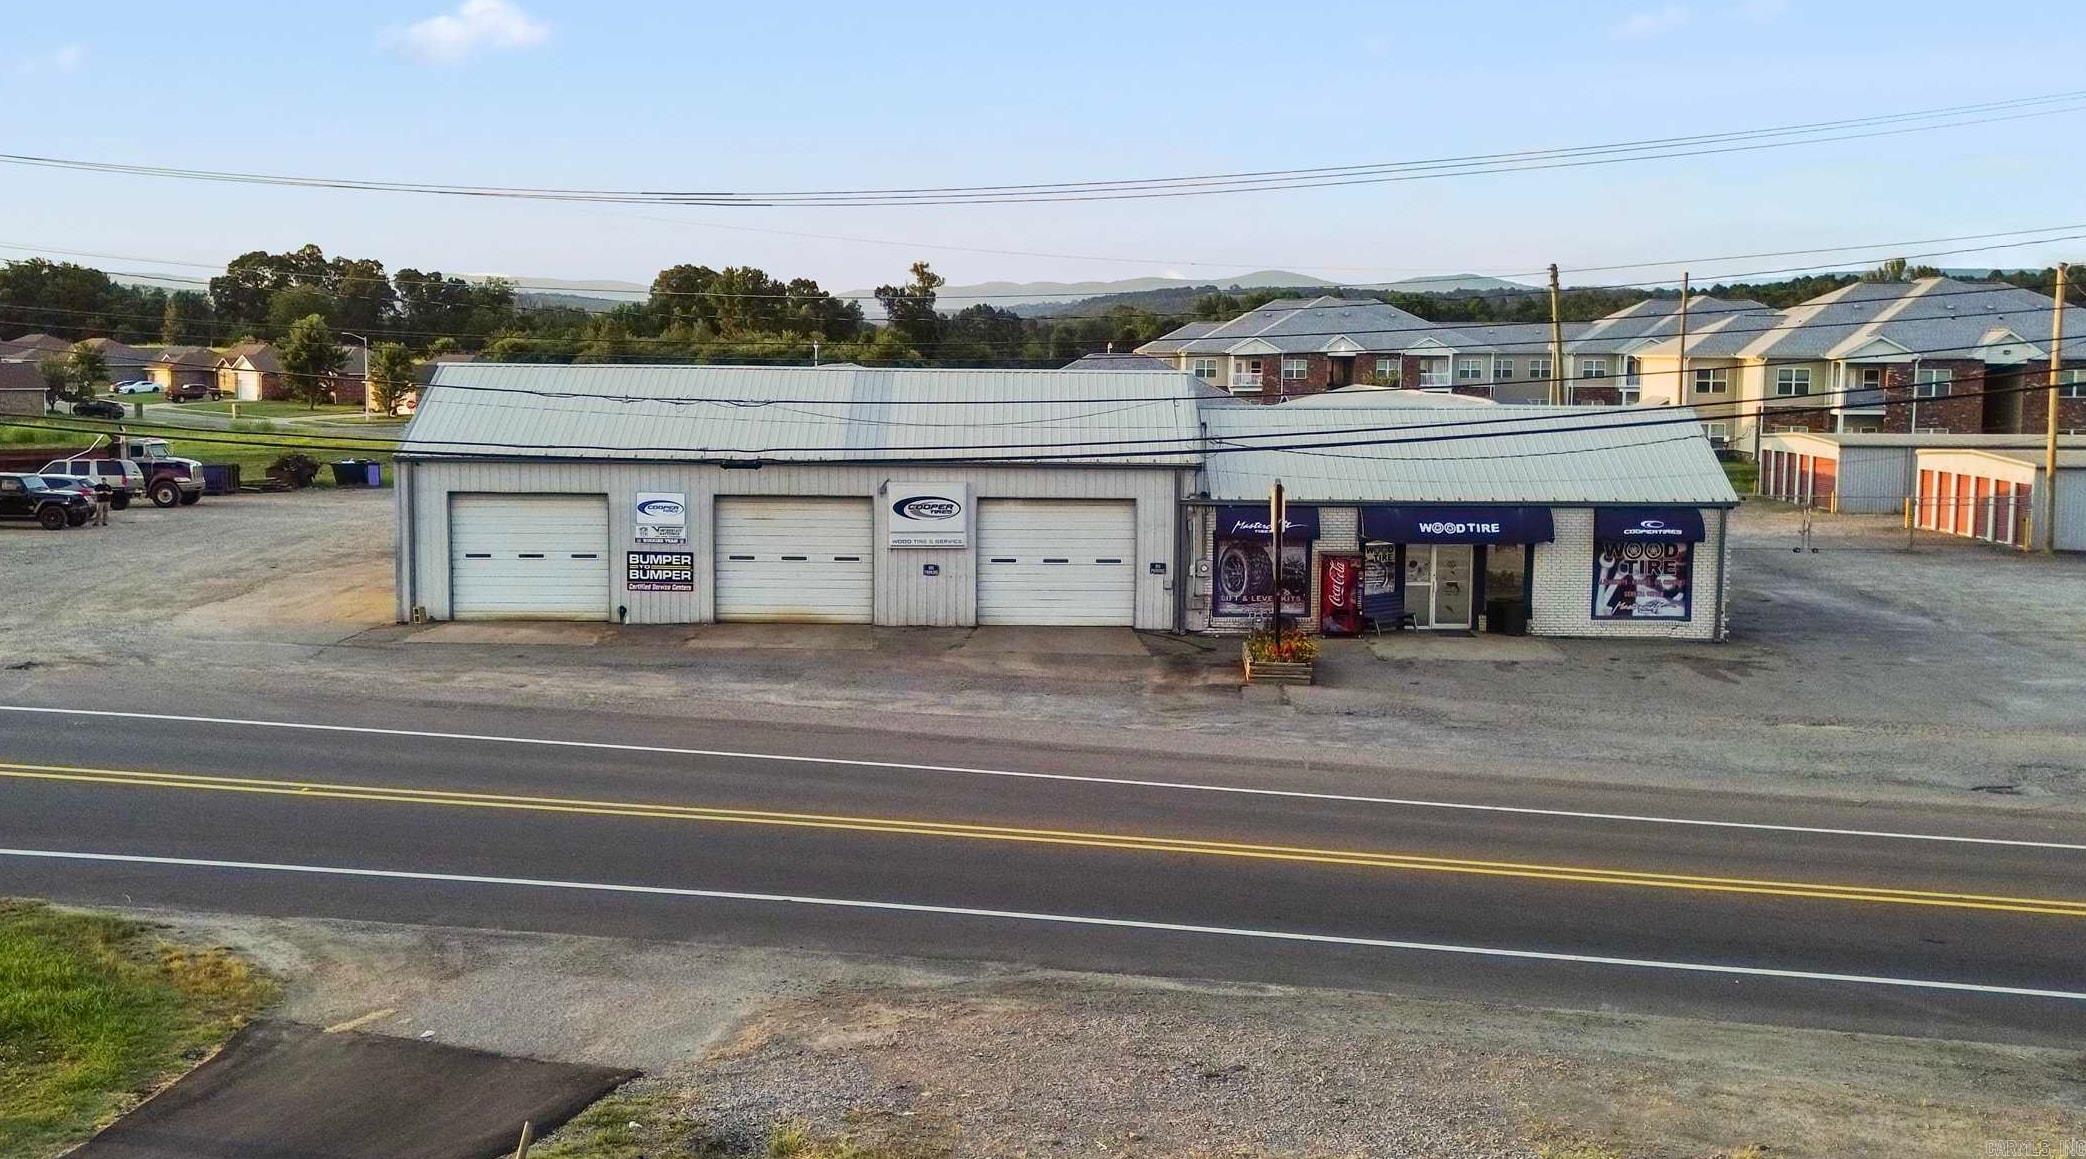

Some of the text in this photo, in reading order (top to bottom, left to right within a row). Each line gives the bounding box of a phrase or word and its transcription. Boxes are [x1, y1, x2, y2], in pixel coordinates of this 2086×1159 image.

[1419, 522, 1500, 534] WOOD TIRE
[1602, 541, 1680, 559] WOOD
[629, 554, 691, 565] BUMPER
[1624, 559, 1677, 575] TIRE
[629, 570, 691, 580] BUMPER
